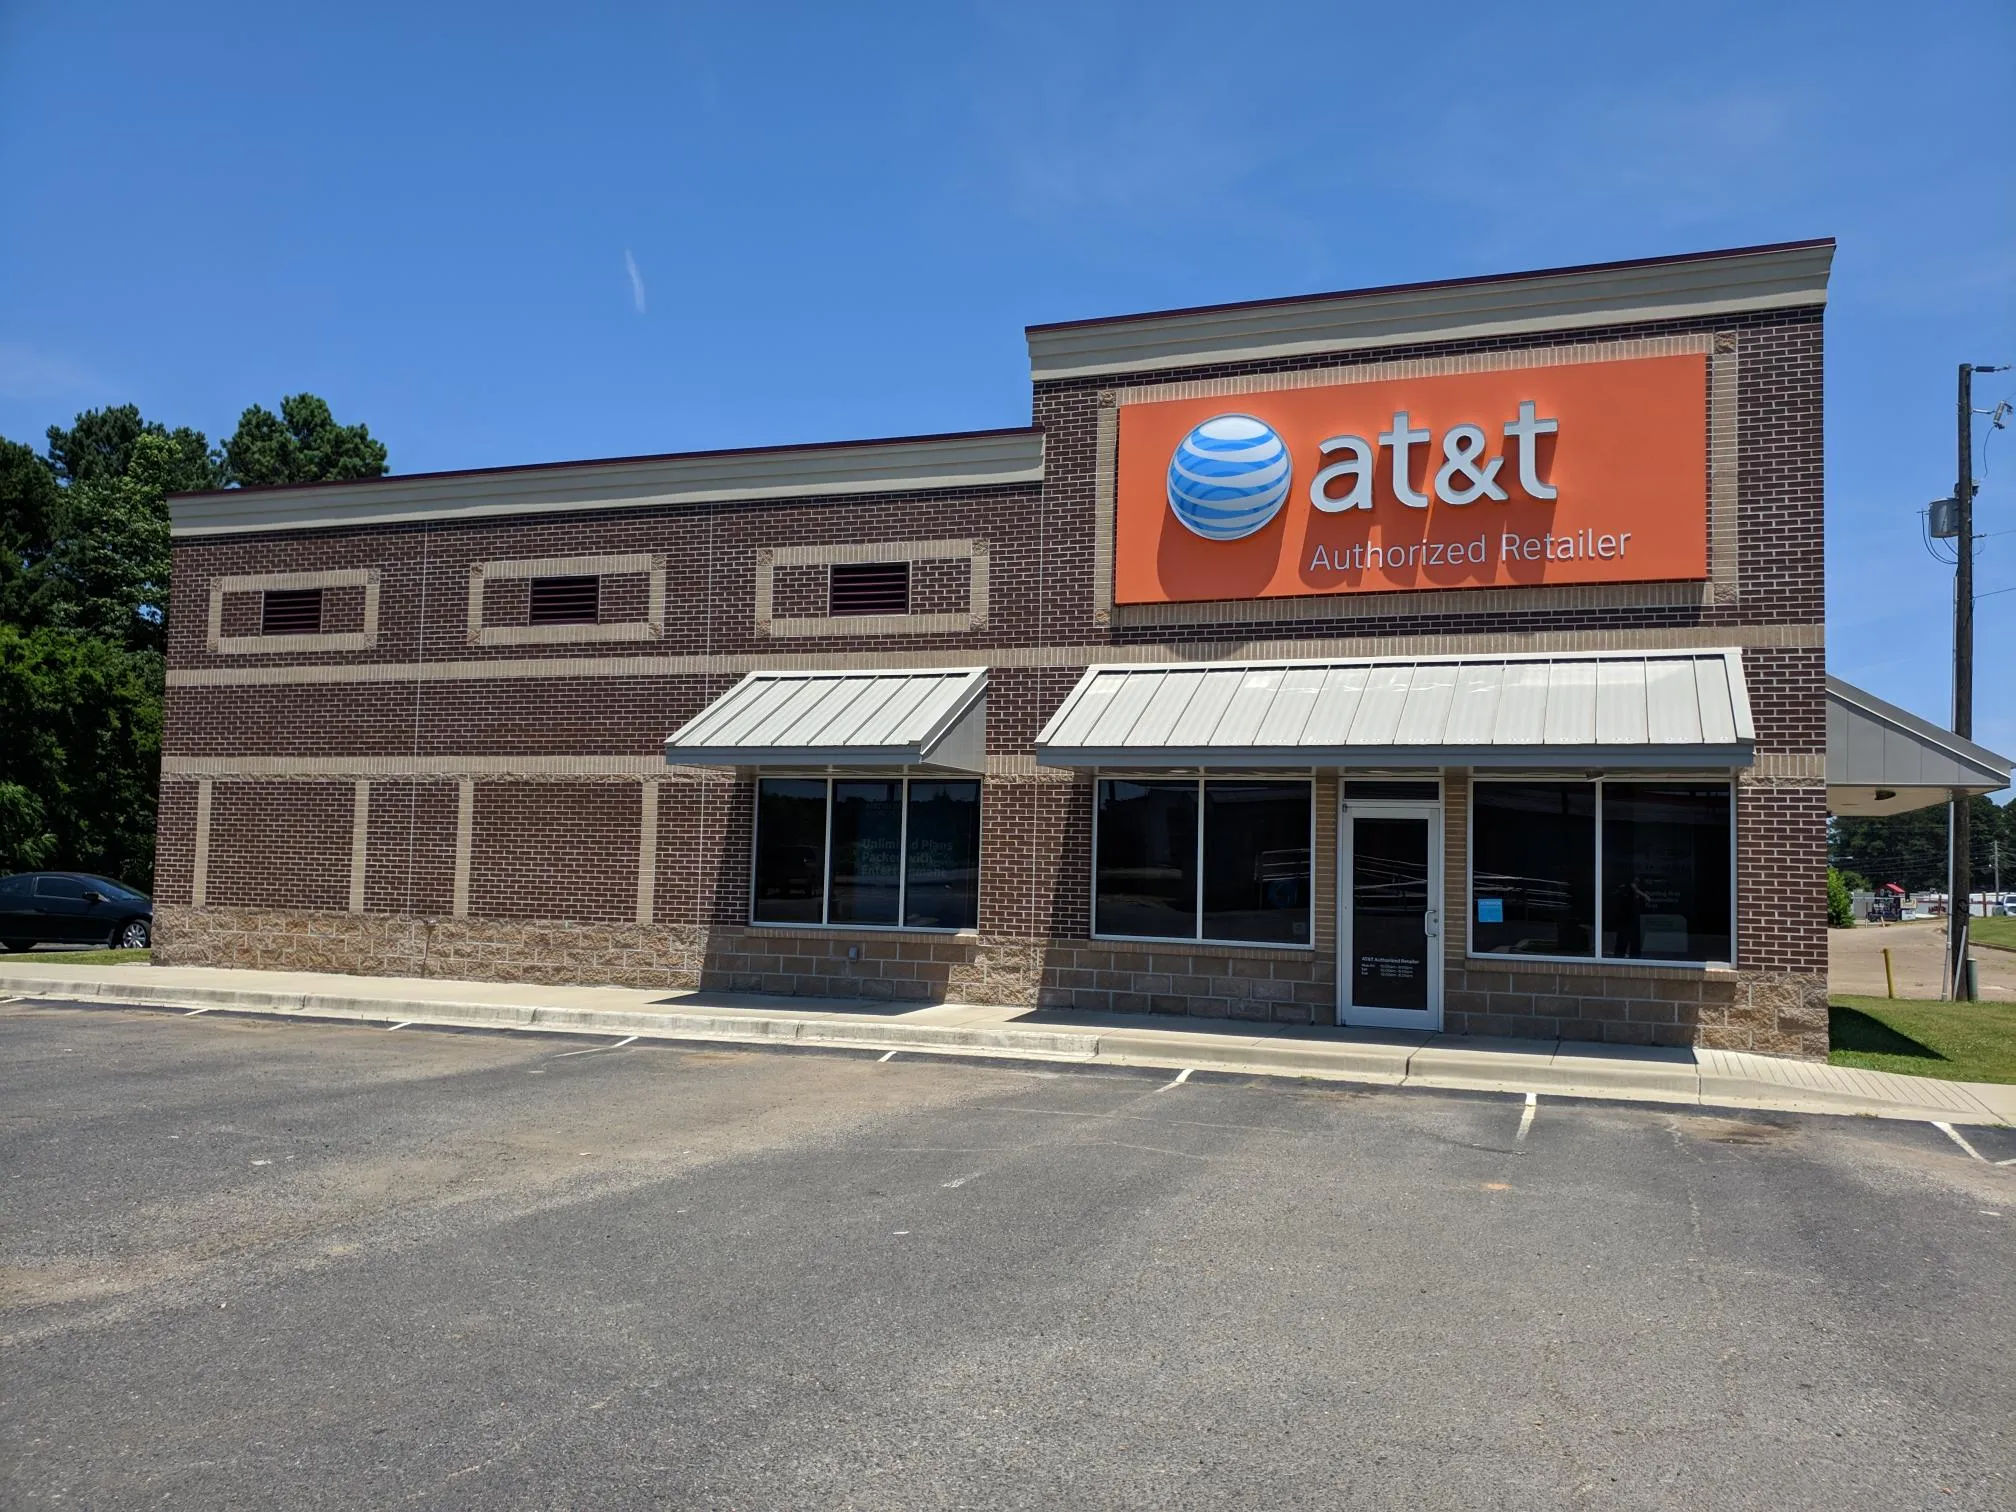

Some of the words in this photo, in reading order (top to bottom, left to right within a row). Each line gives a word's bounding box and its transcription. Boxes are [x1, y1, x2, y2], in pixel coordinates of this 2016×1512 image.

[1310, 400, 1558, 513] at&t
[1310, 534, 1486, 572] Authorized
[1501, 529, 1632, 564] Retailer
